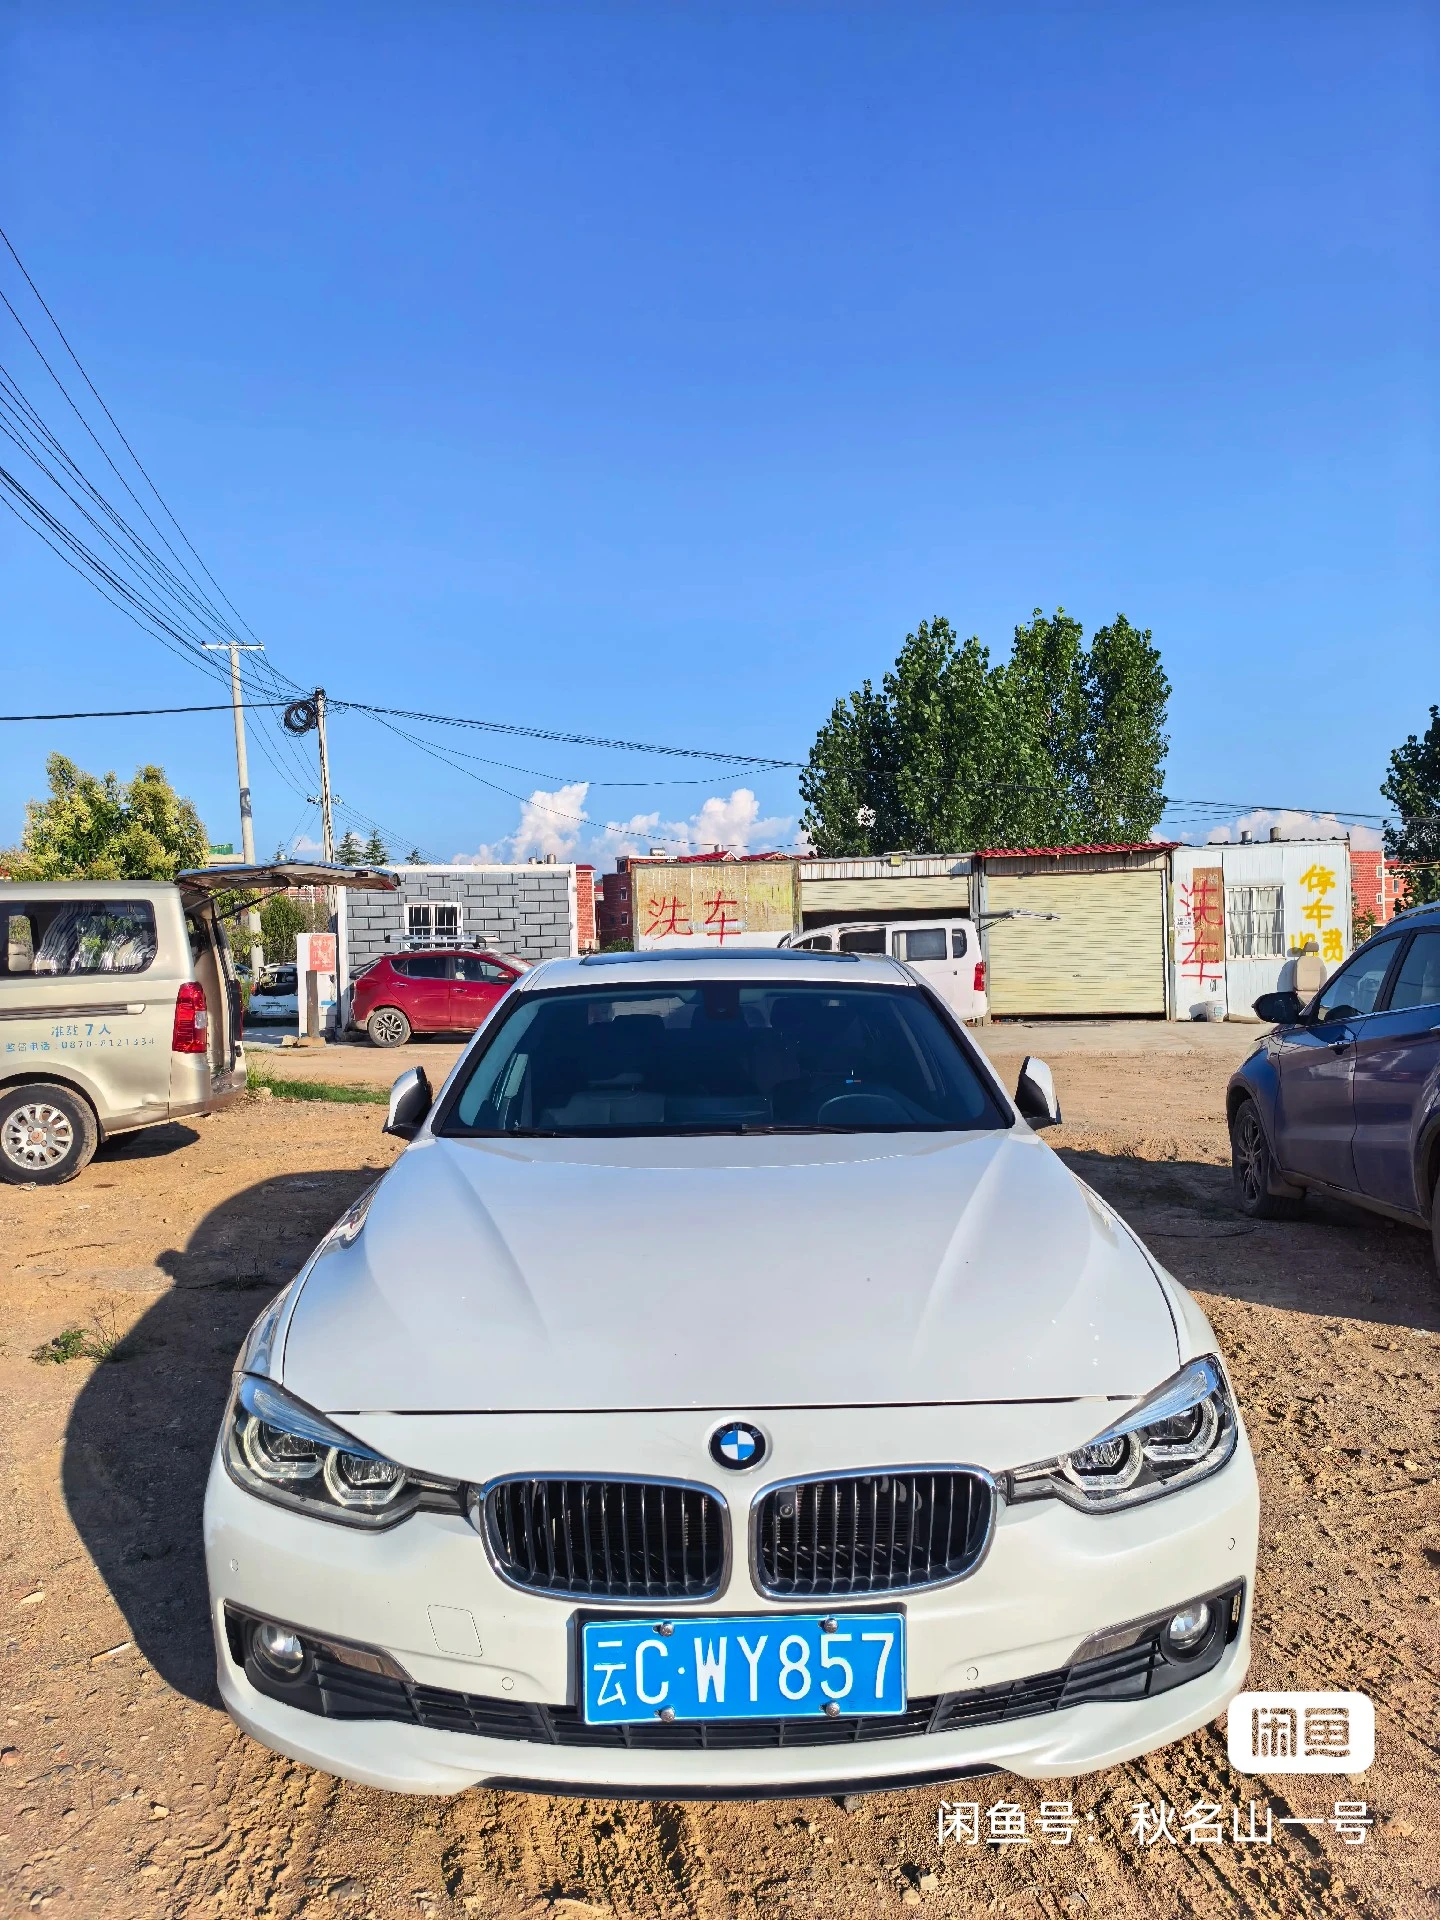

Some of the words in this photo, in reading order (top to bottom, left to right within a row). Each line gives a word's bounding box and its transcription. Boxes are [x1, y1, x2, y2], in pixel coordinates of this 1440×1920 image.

[644, 889, 742, 946] 洗车
[1179, 879, 1223, 986] 洗车
[715, 1423, 762, 1439] BMW
